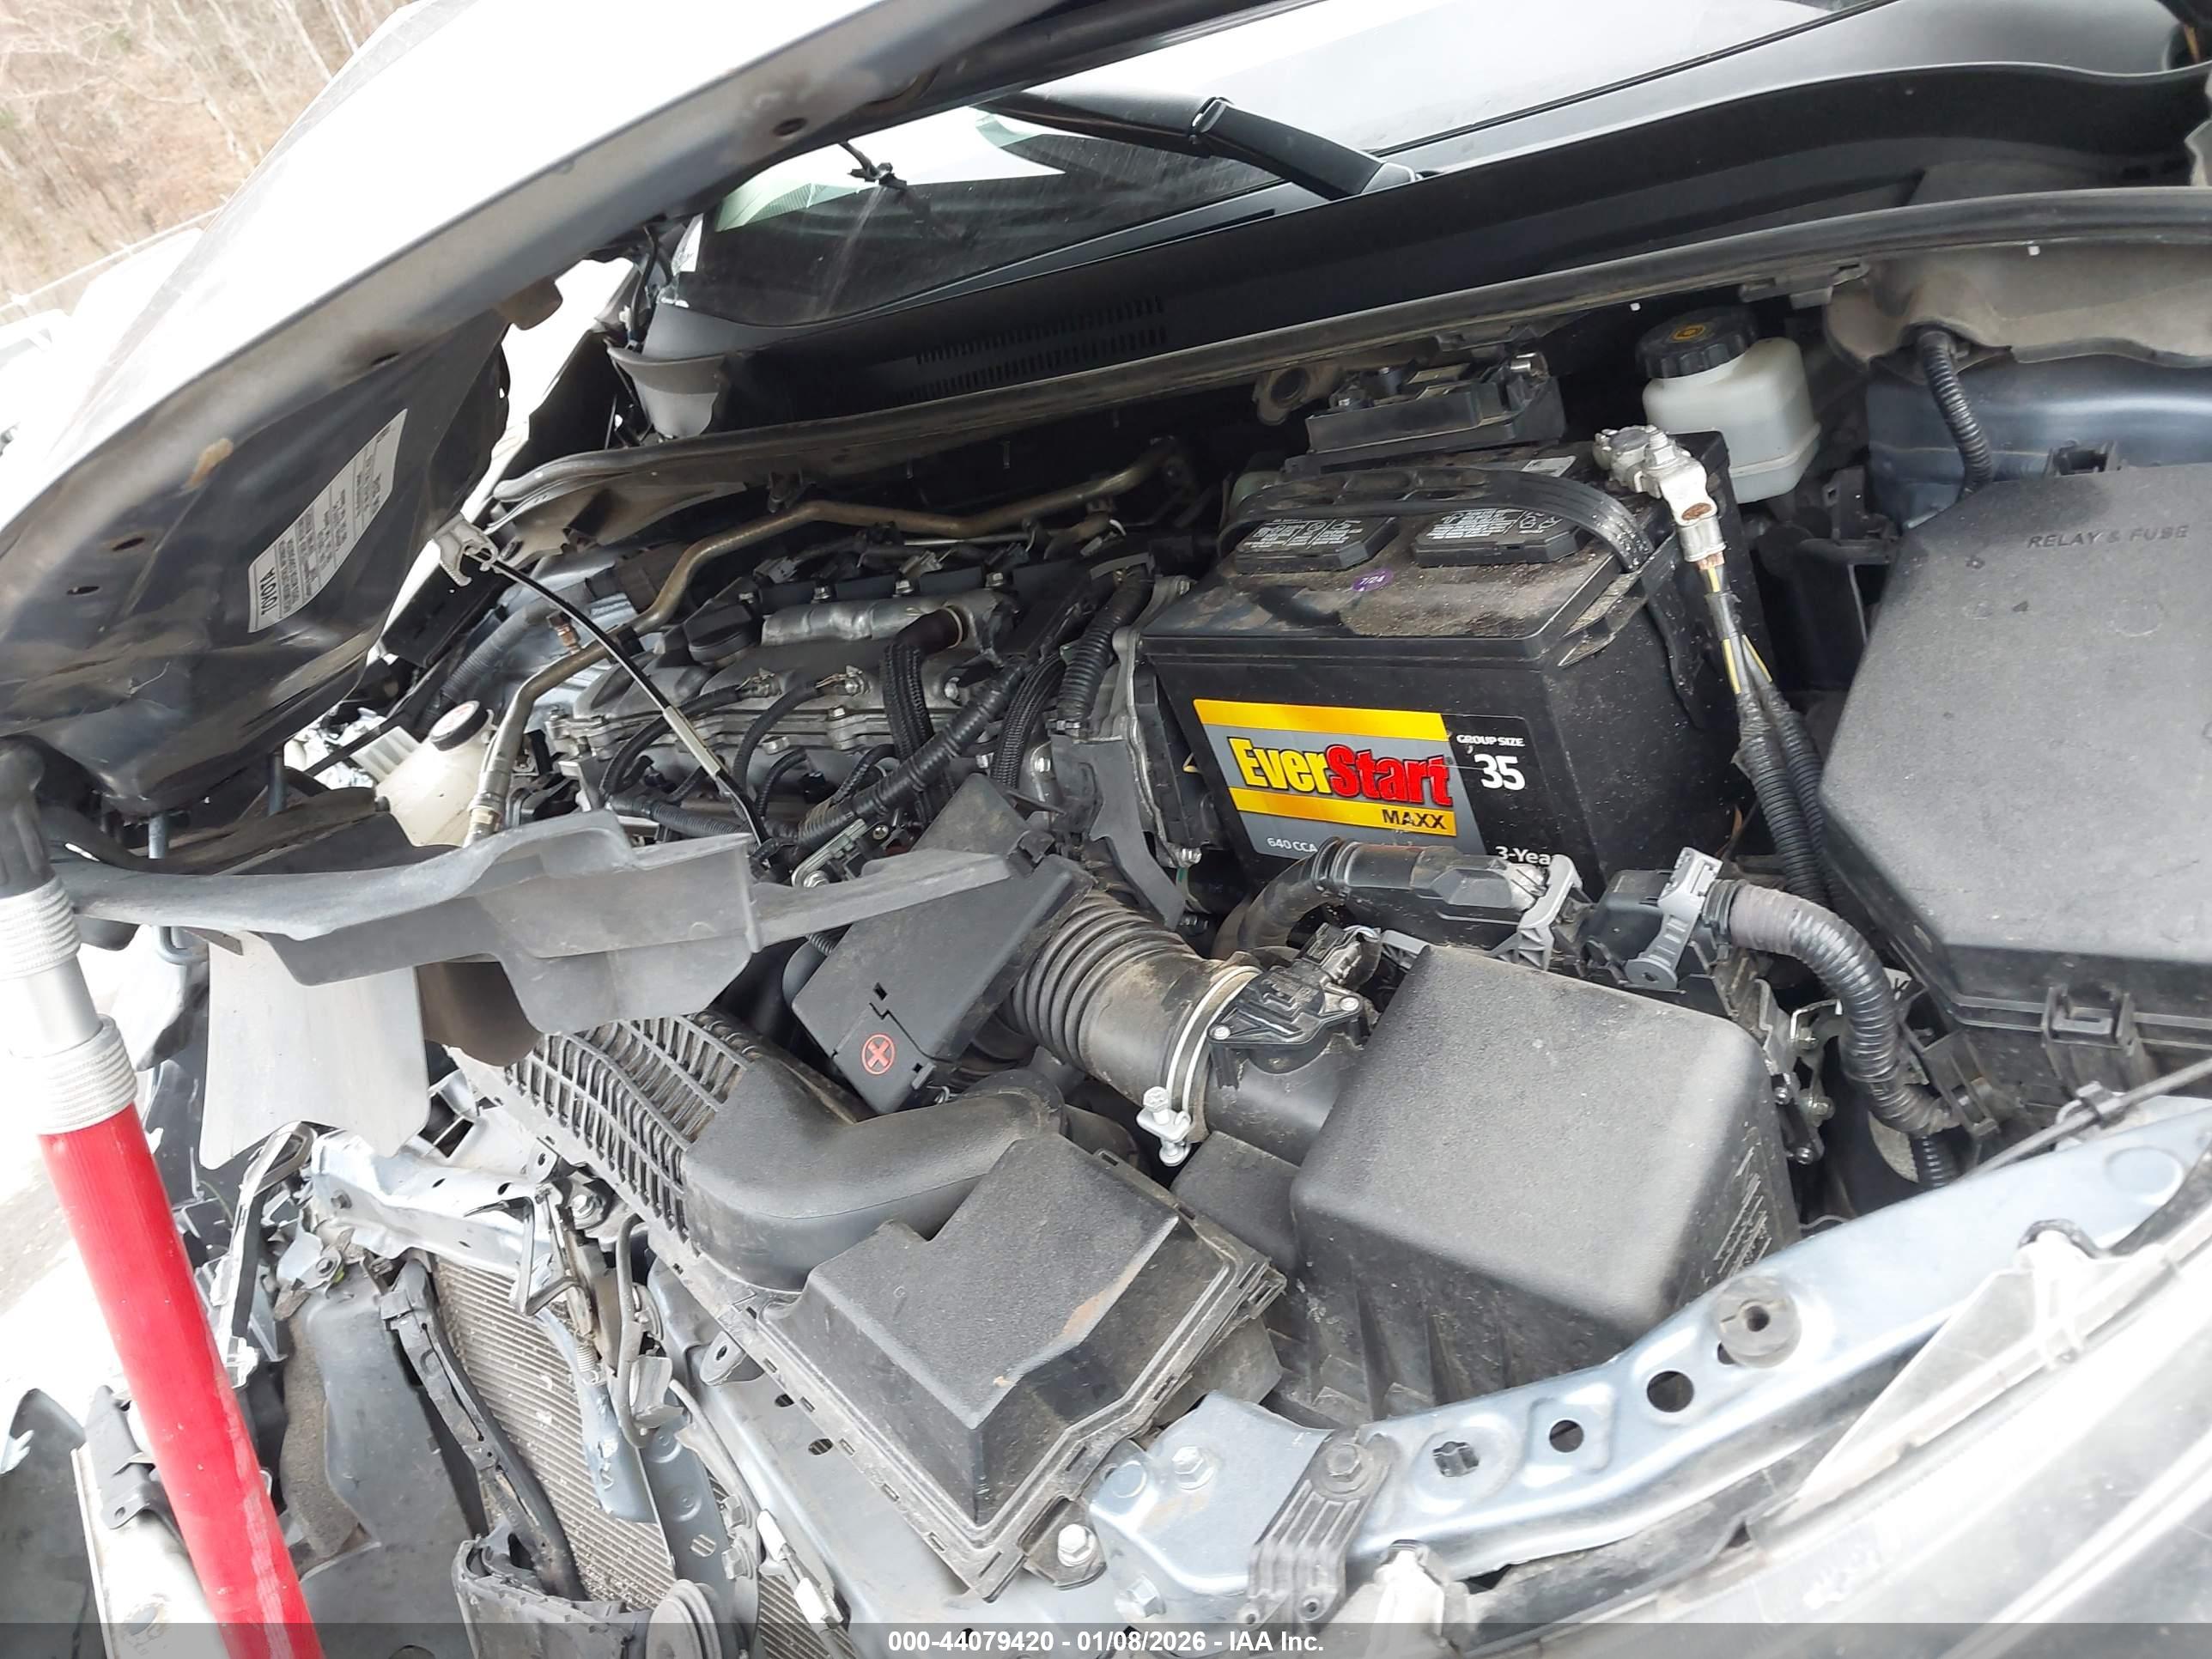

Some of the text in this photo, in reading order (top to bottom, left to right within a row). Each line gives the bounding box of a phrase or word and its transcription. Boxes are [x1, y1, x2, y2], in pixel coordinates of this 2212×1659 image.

[2027, 525, 2190, 549] RELAY & FUSE
[260, 566, 278, 616] TOYOTA
[1455, 734, 1526, 747] GROUP SIZE
[1227, 736, 1454, 807] EverStart
[1474, 753, 1526, 791] 35
[1382, 809, 1447, 830] MAXX
[1267, 836, 1319, 853] 640 CCA
[1495, 846, 1553, 866] 3-Yea
